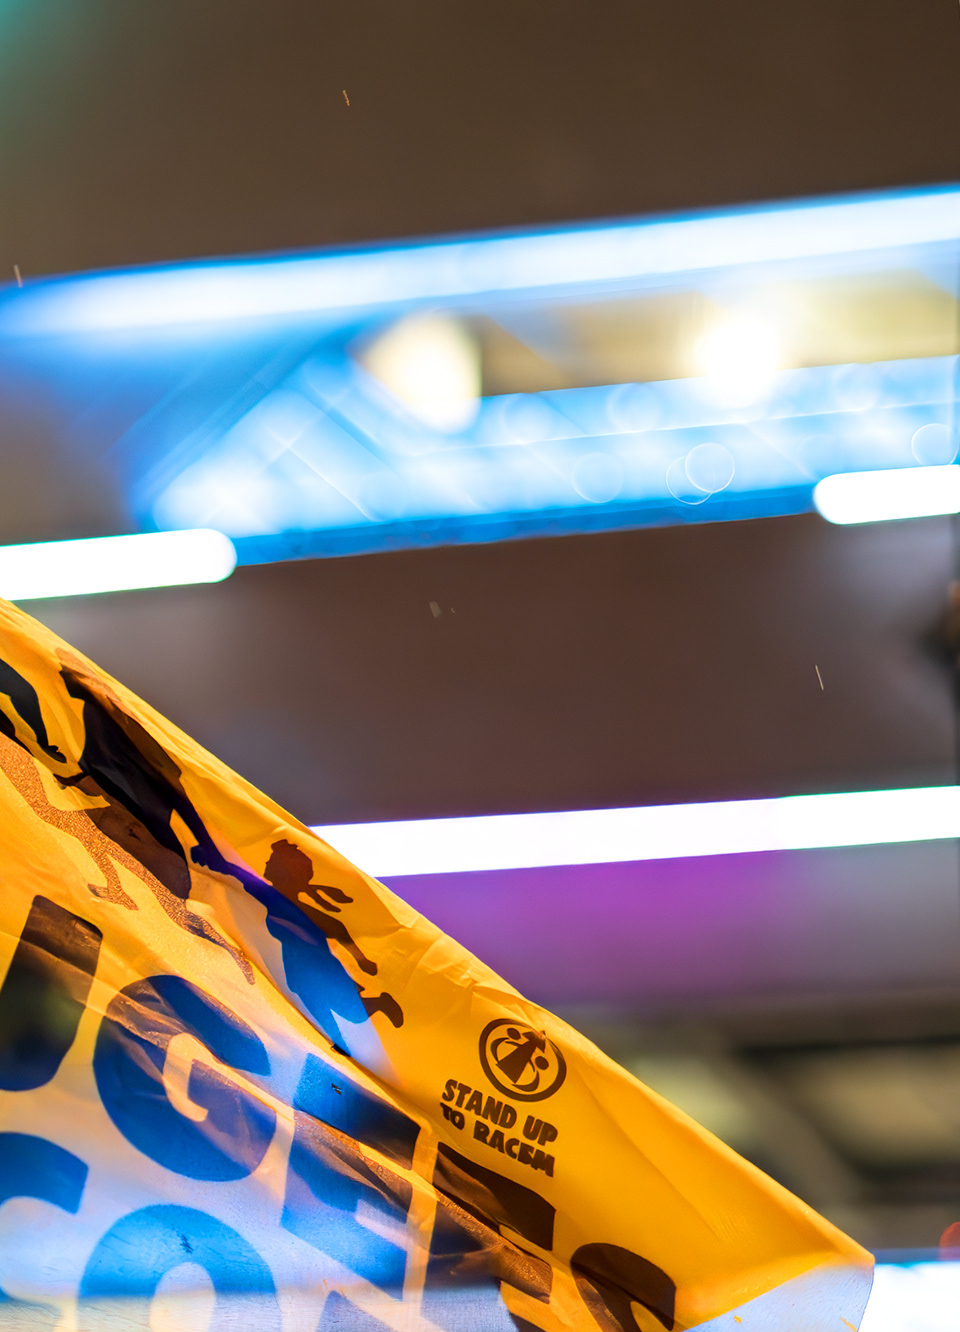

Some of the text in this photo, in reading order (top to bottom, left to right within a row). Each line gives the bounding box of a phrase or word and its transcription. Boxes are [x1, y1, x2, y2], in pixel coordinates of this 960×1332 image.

[440, 1102, 465, 1130] TO
[442, 1079, 558, 1146] STAND UP
